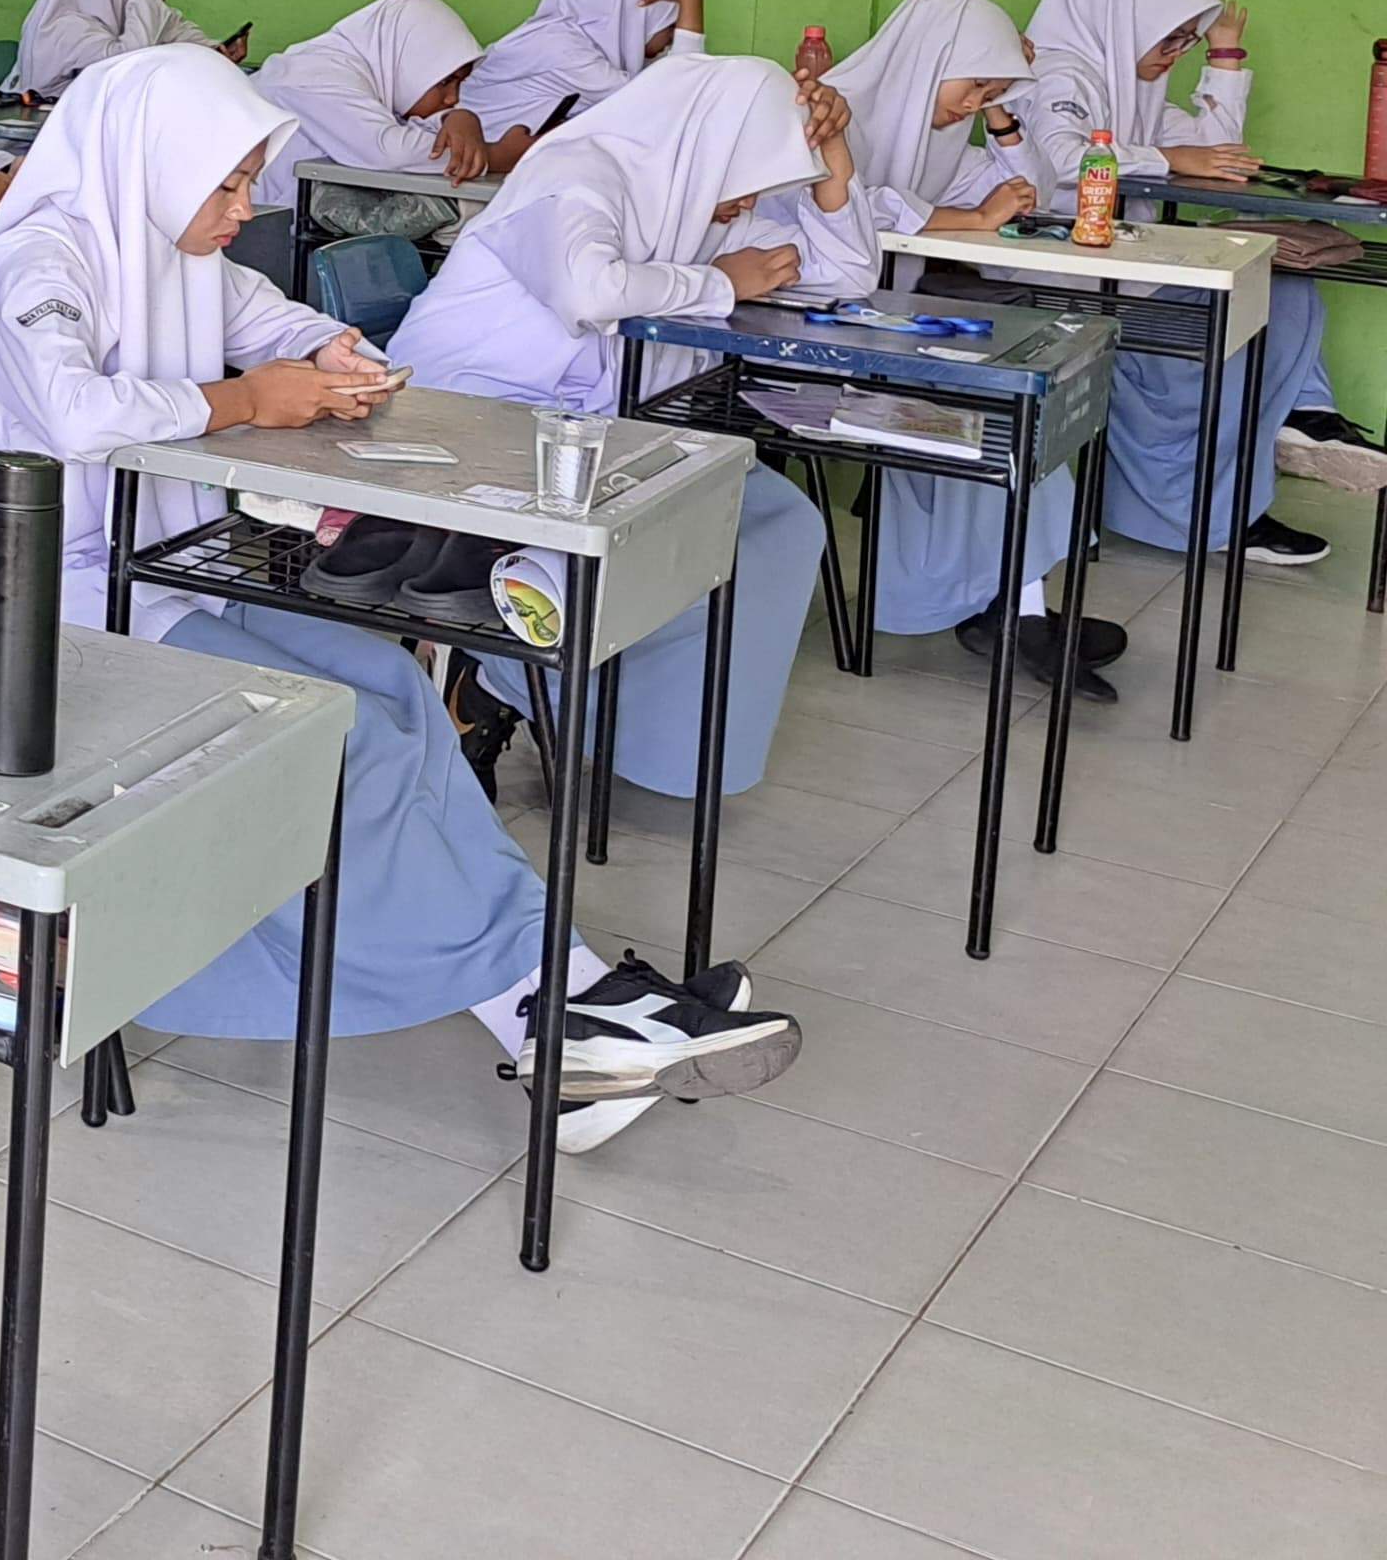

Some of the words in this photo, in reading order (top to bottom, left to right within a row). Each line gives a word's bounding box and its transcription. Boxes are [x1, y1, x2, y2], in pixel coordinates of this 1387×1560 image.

[1088, 167, 1110, 180] Nü
[1082, 186, 1113, 195] GREEN
[1087, 196, 1106, 204] TEA
